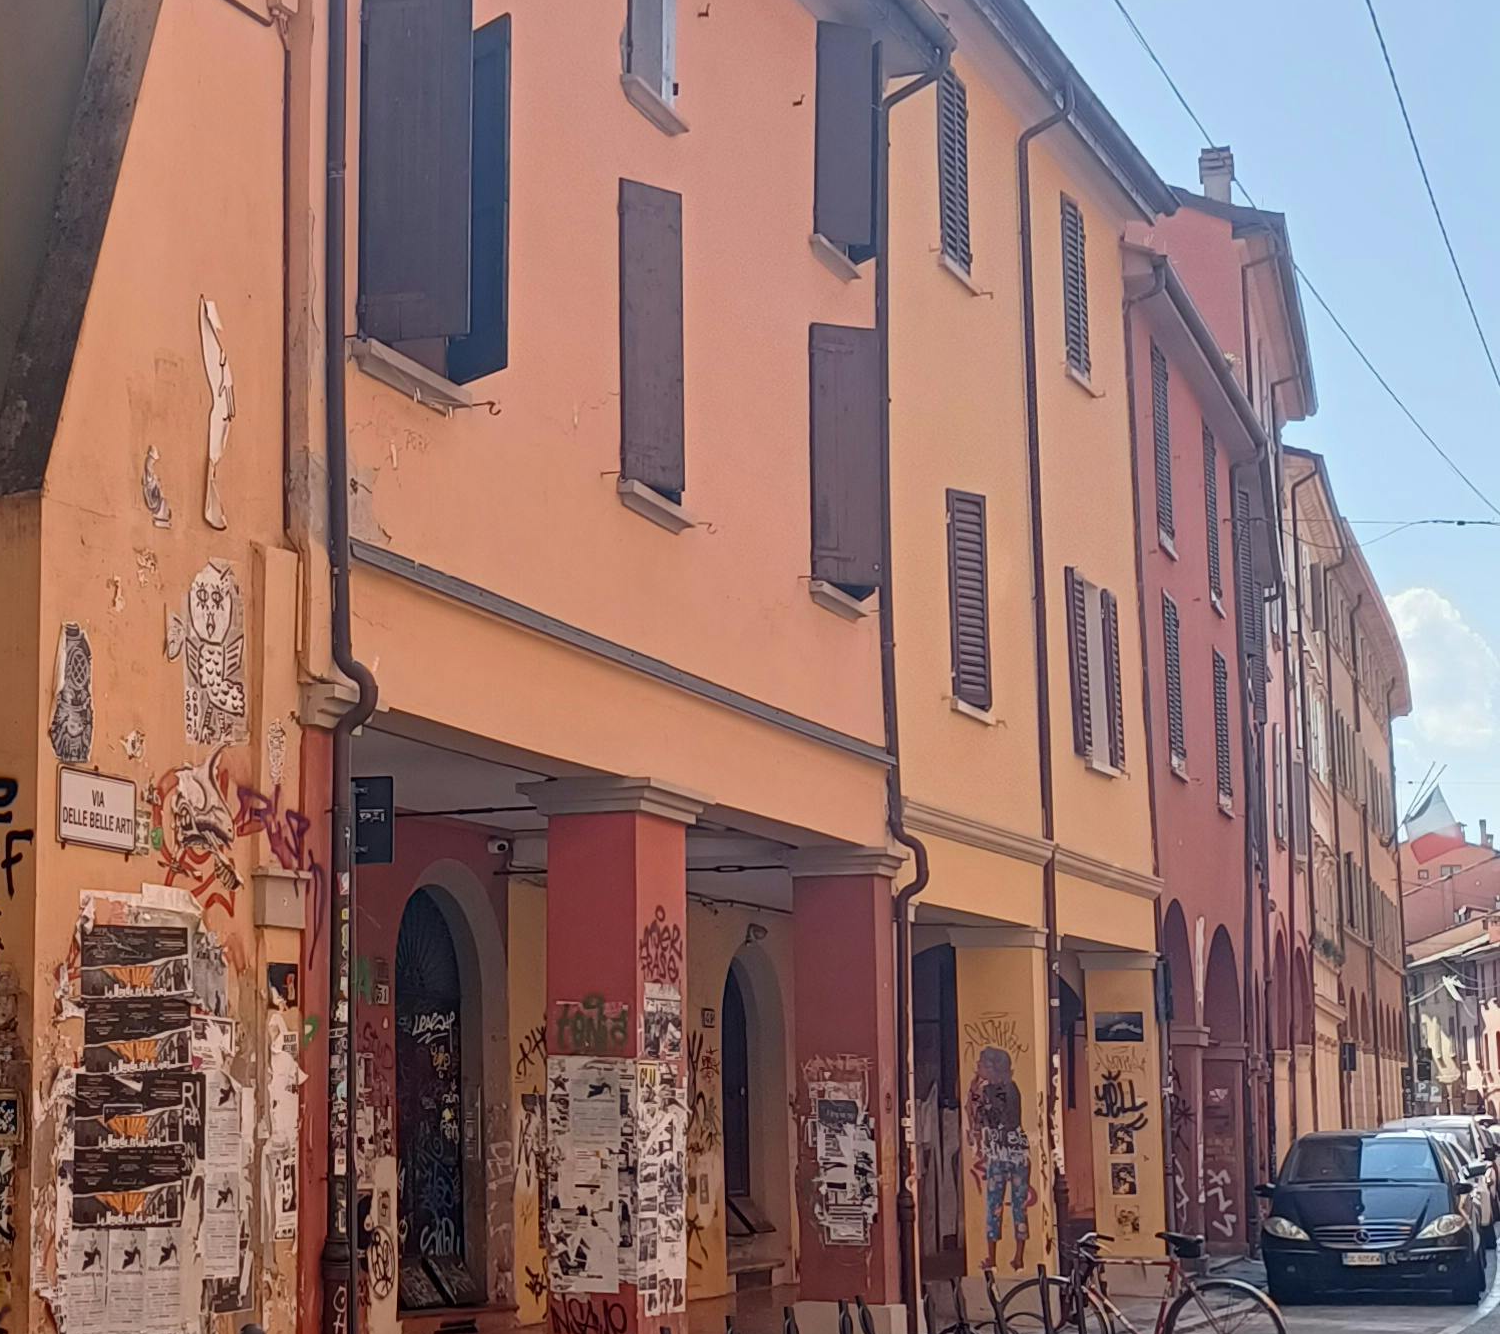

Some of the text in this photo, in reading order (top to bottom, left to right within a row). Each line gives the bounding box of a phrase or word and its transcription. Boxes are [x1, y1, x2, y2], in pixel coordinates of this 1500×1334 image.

[92, 789, 105, 808] VIA
[62, 806, 133, 835] DELLE BELLE ARTI
